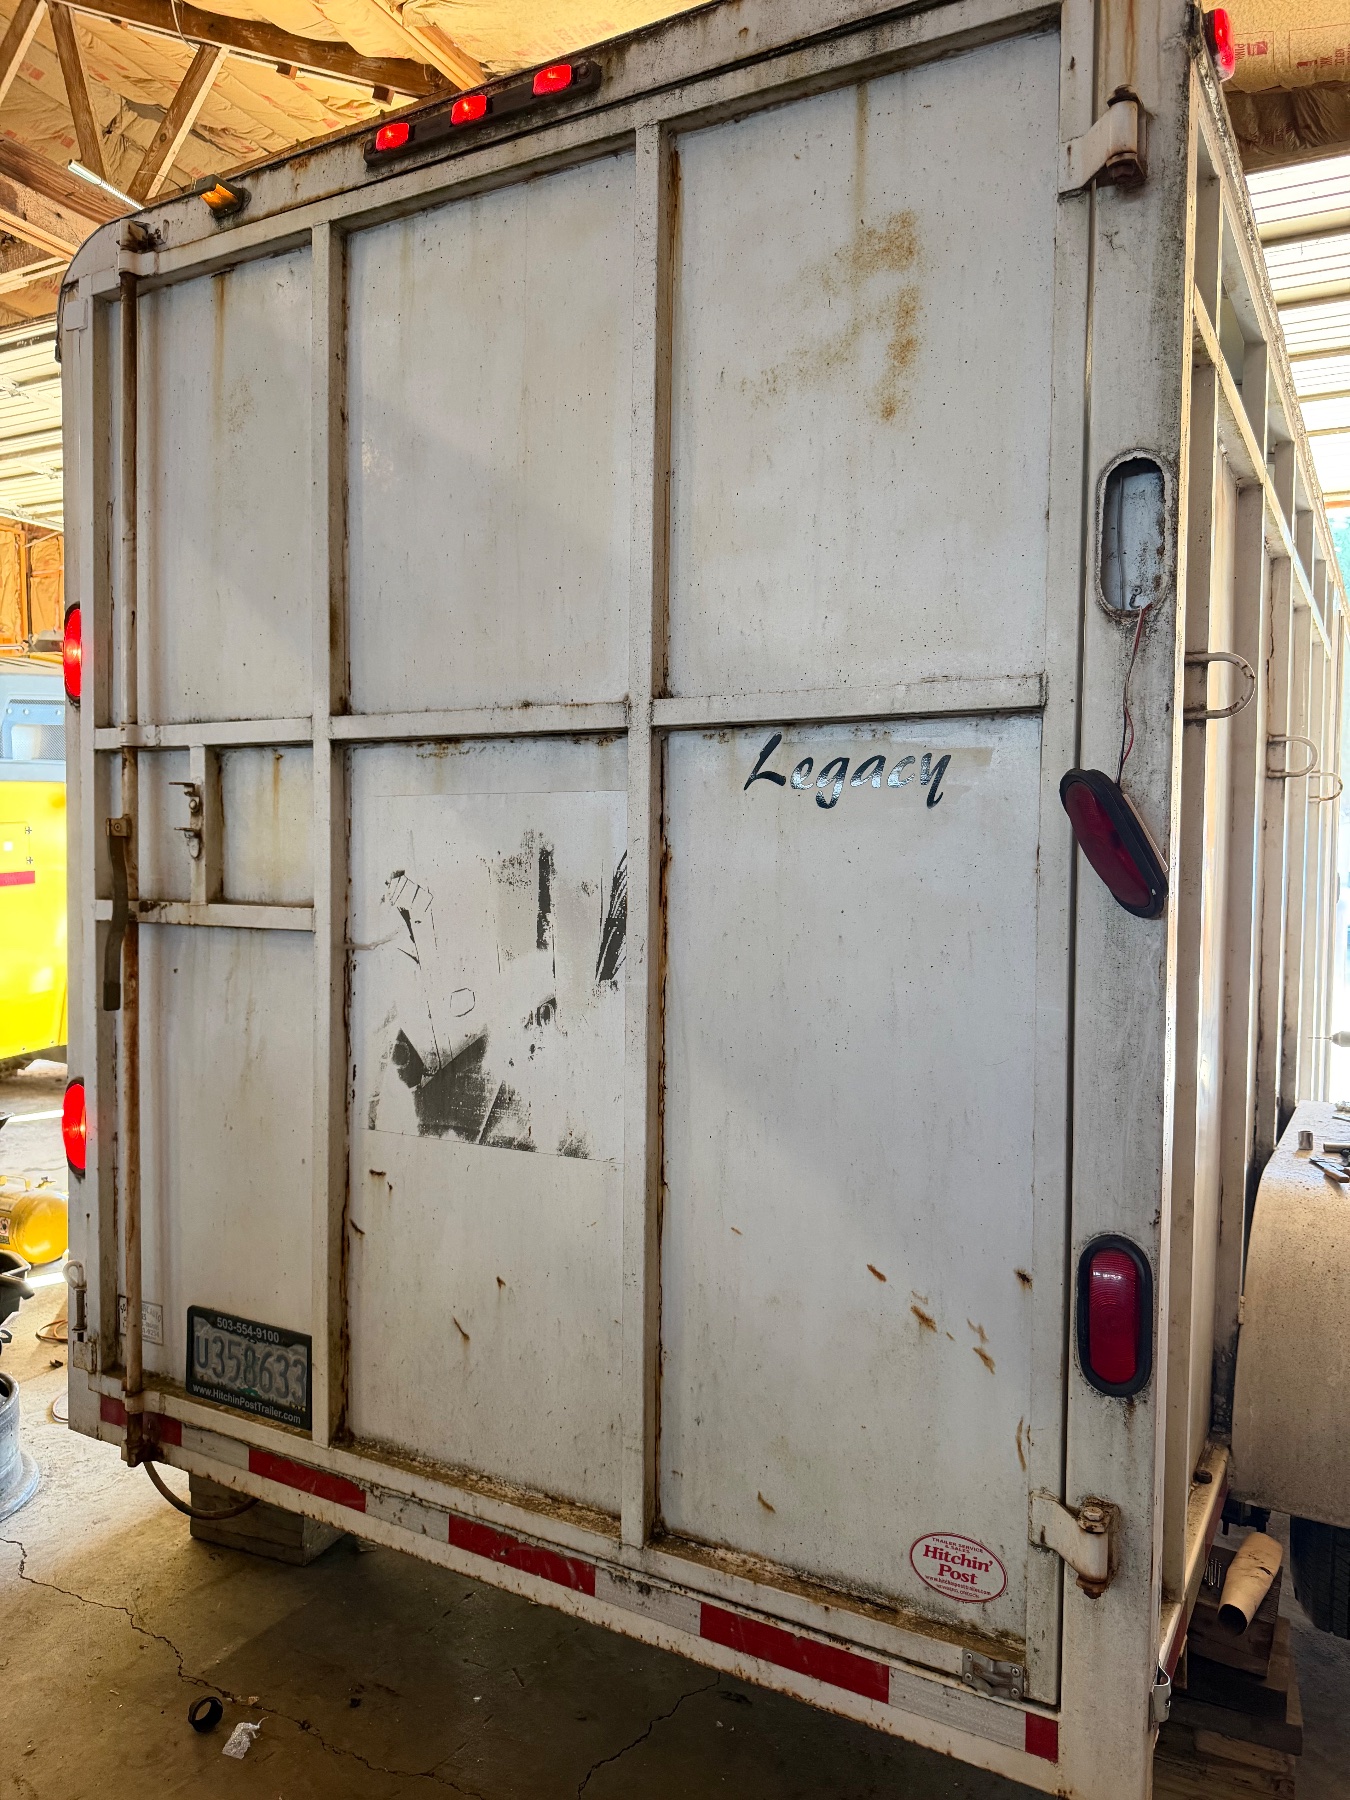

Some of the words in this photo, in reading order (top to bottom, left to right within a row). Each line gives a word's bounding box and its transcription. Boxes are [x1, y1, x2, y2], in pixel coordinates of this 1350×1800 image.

[743, 731, 951, 809] Legacy
[217, 1317, 279, 1343] 503-554-9100
[195, 1333, 306, 1405] U358633
[193, 1384, 301, 1424] www.HitchinPostTrailer.com
[923, 1544, 993, 1573] Hitchin'
[932, 1537, 957, 1547] TRAILER
[958, 1543, 984, 1553] SERVICE
[951, 1545, 970, 1554] SALES
[937, 1563, 978, 1585] Post
